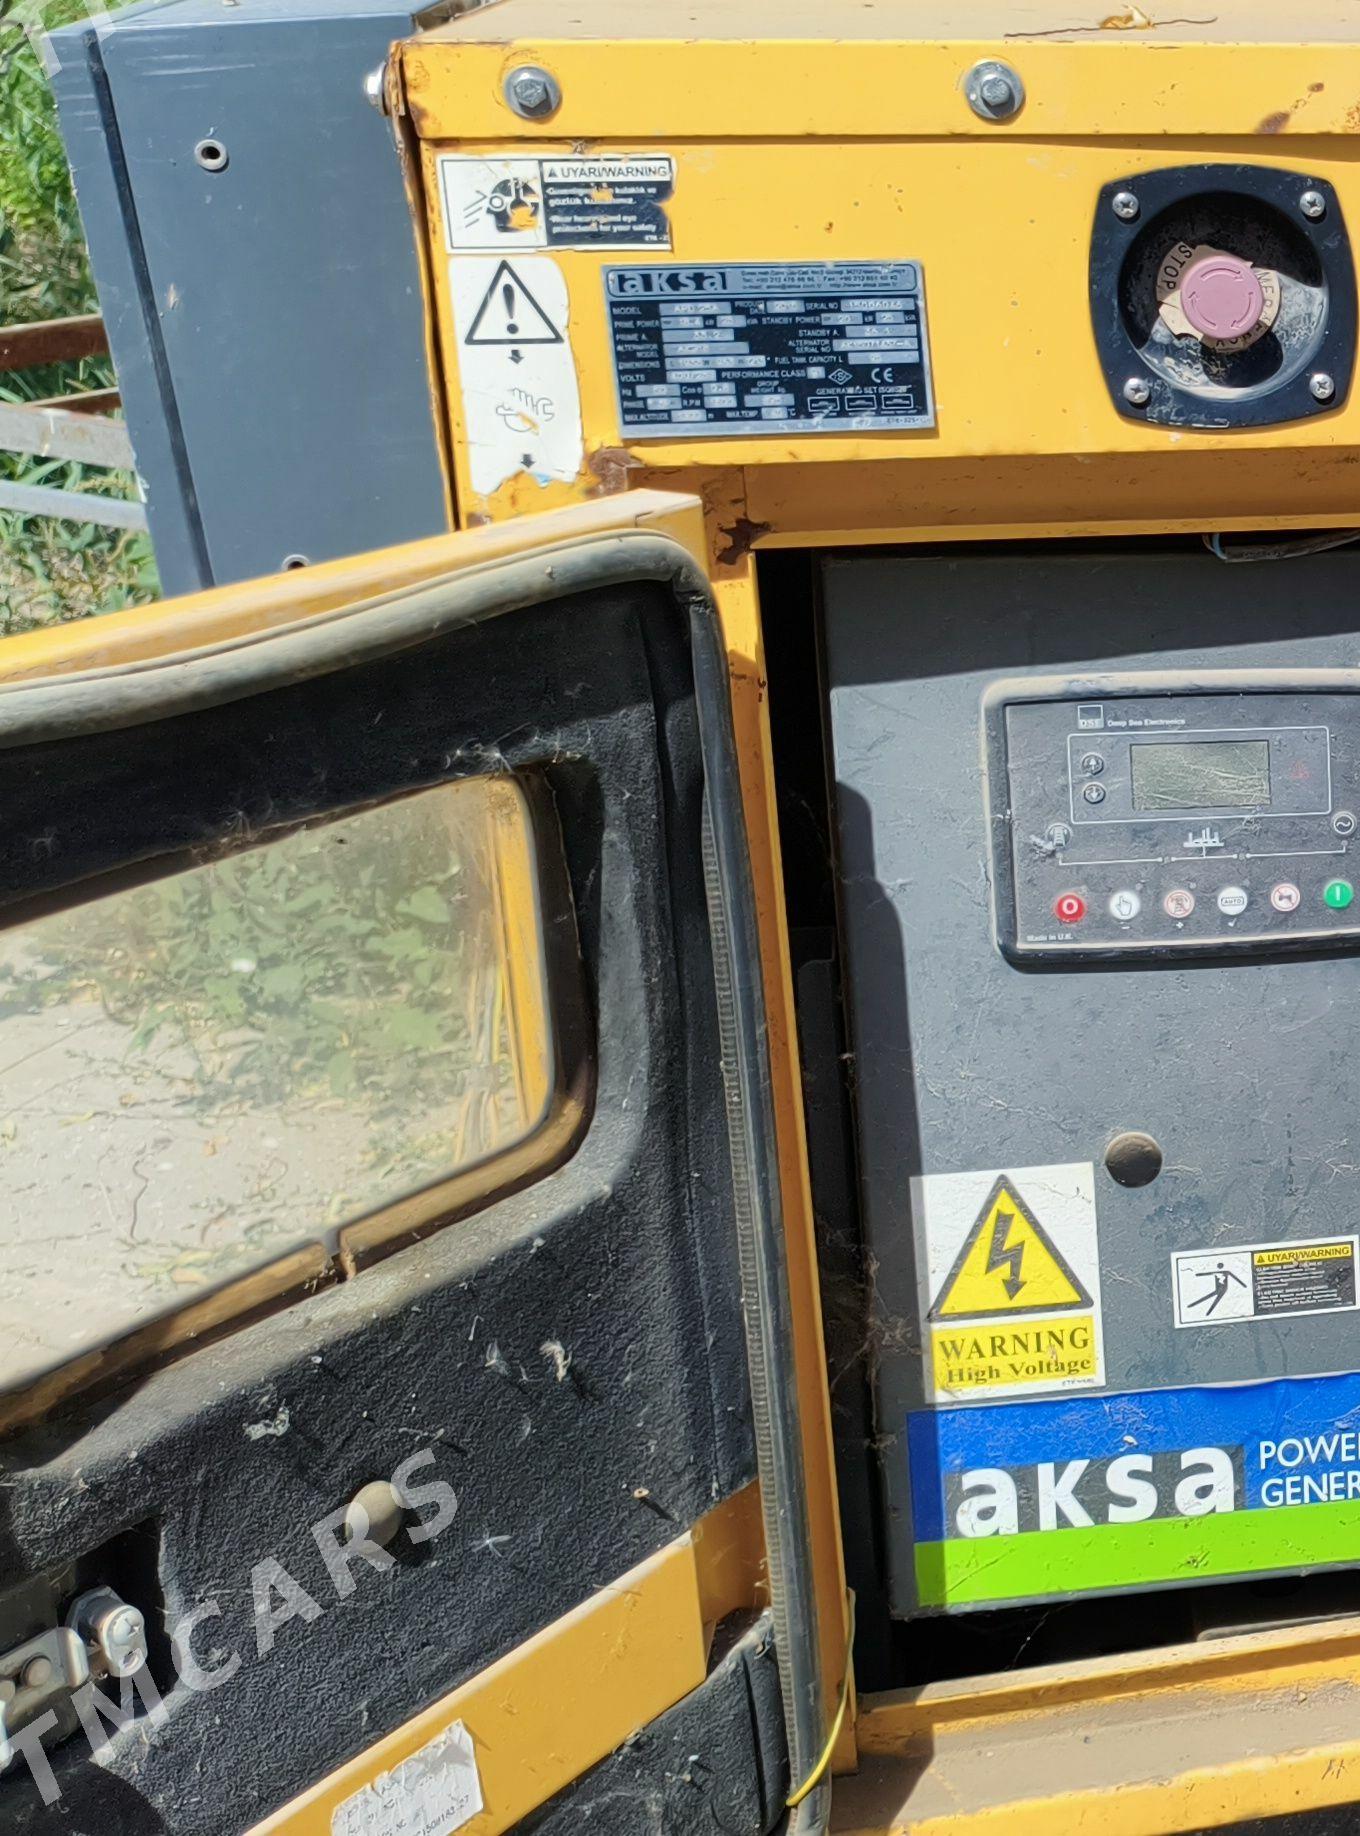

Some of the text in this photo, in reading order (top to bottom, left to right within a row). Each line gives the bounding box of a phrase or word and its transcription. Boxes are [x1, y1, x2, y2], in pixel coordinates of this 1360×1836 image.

[620, 271, 725, 292] aksa
[721, 370, 779, 379] PERFORMANCE
[780, 370, 807, 378] CLASS
[1267, 1246, 1350, 1263] UYARI/WARNING
[938, 1326, 1090, 1362] WARNING
[948, 1356, 1091, 1385] High Voltage
[954, 1445, 1235, 1538] aksa
